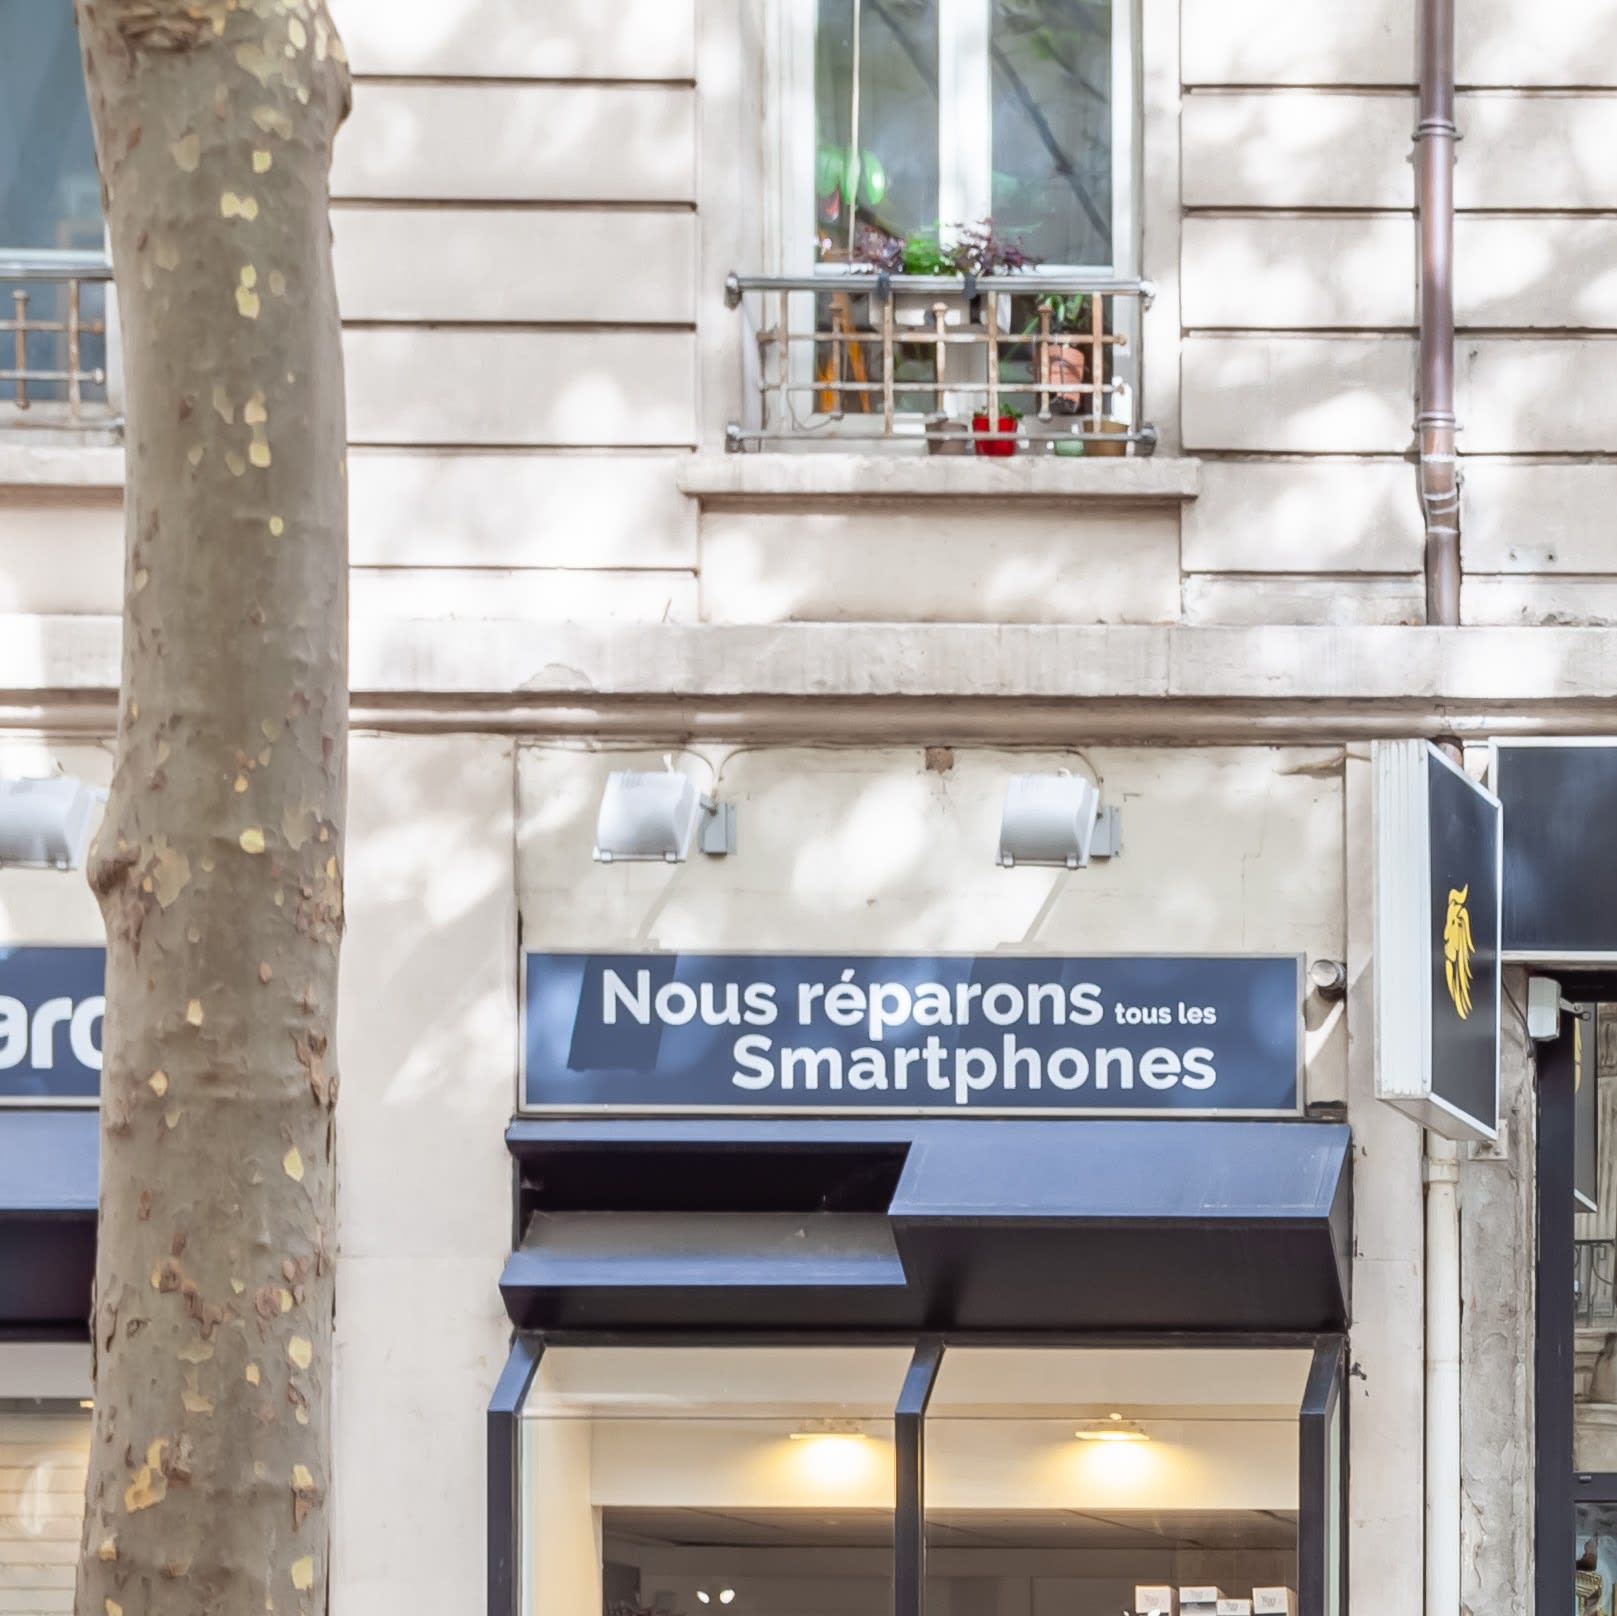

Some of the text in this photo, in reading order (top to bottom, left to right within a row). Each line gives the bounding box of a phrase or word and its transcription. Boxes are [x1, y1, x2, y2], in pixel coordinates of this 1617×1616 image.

[602, 968, 1217, 1040] Nous réparons tous les
[732, 1034, 1217, 1104] Smartphones
